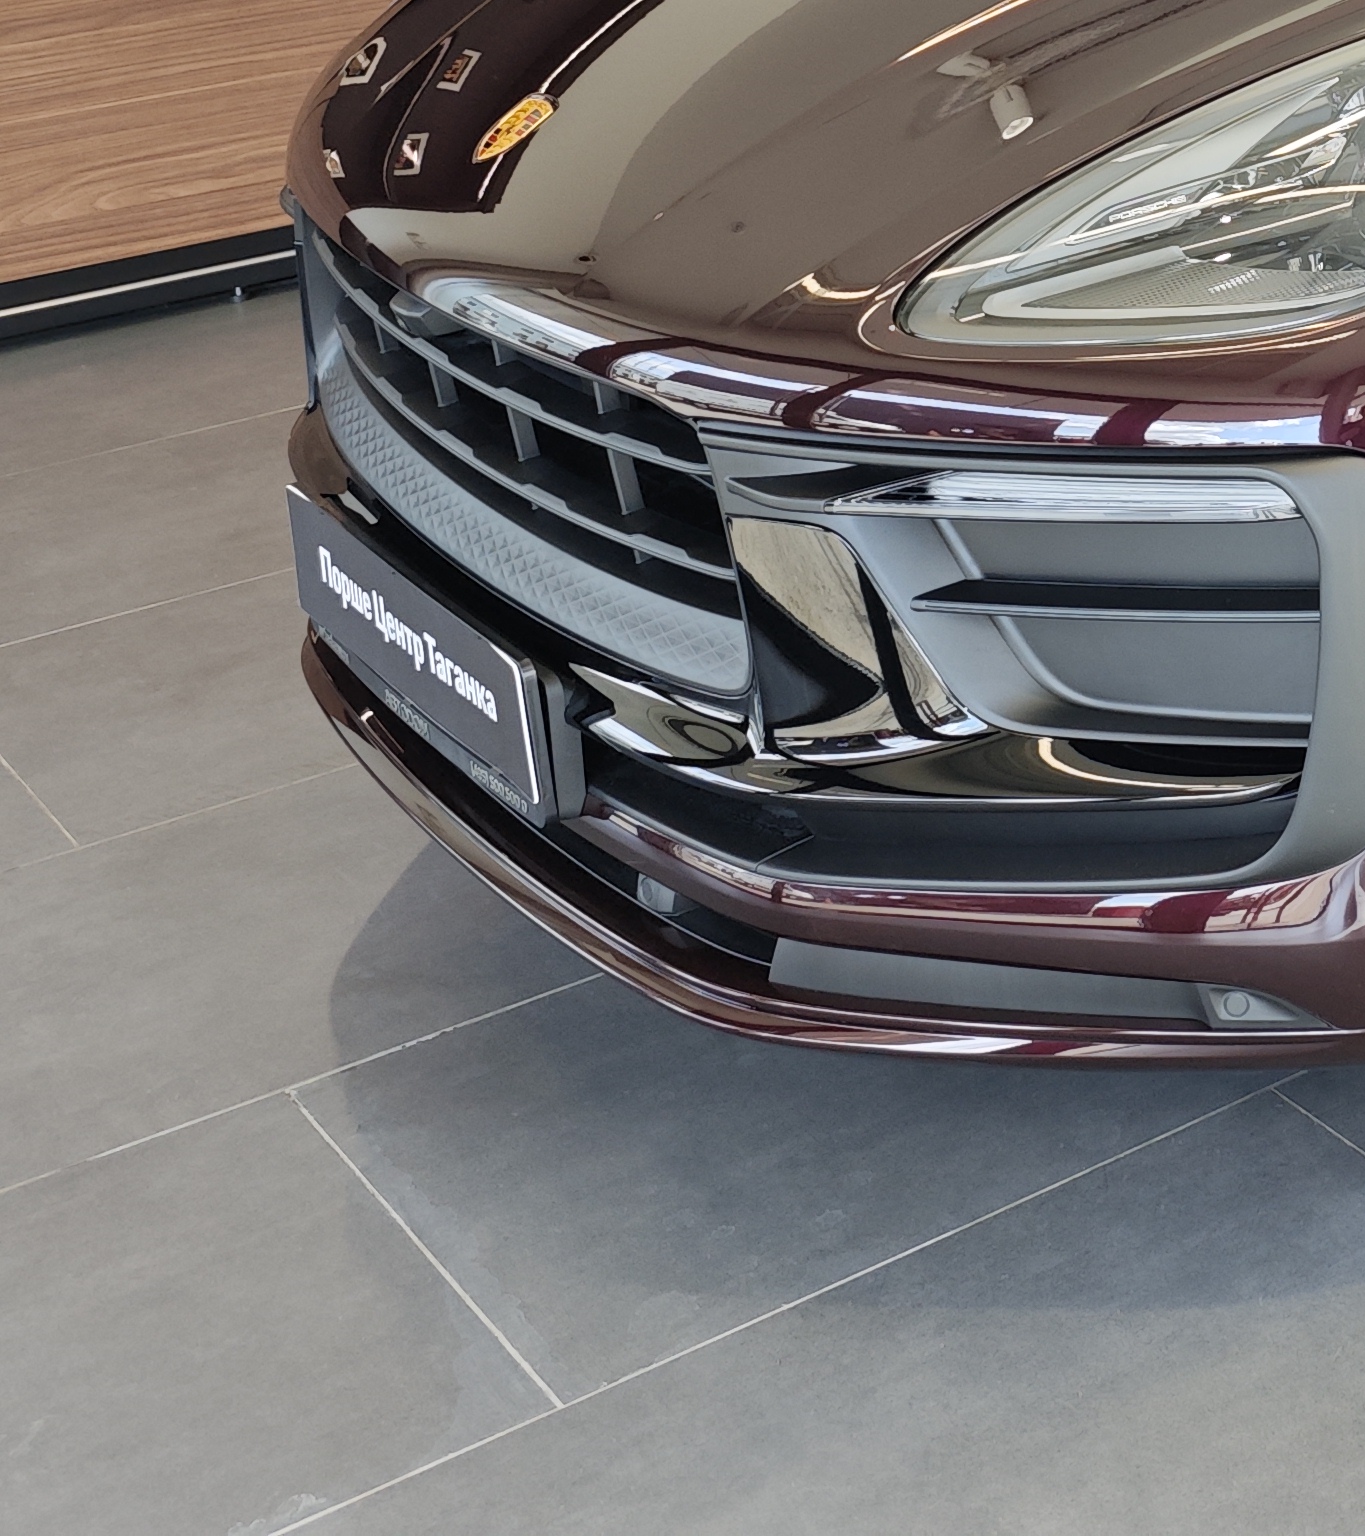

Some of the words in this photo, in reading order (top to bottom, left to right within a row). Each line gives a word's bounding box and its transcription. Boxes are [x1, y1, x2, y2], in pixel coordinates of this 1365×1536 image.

[318, 545, 372, 620] Порше
[372, 590, 425, 671] Центр
[423, 631, 498, 723] Таганка
